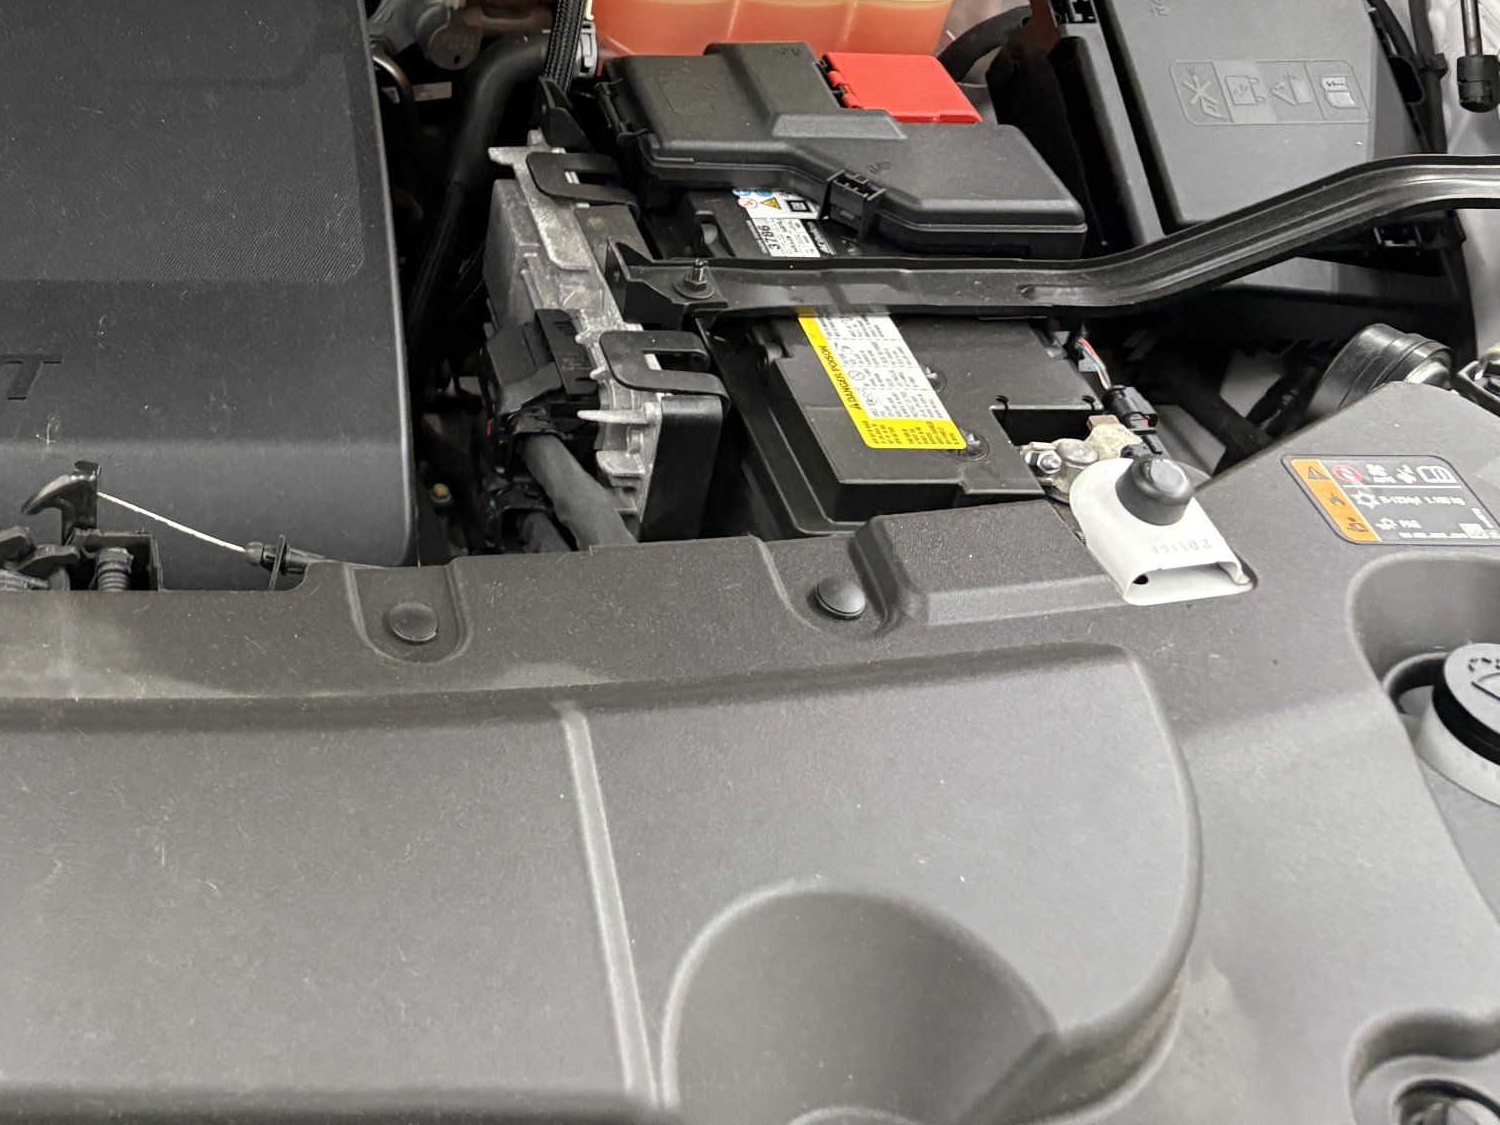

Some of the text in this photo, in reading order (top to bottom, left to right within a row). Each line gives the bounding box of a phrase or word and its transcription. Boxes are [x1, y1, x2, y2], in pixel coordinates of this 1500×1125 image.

[758, 225, 781, 251] 3786
[818, 346, 857, 402] DANGER POISON
